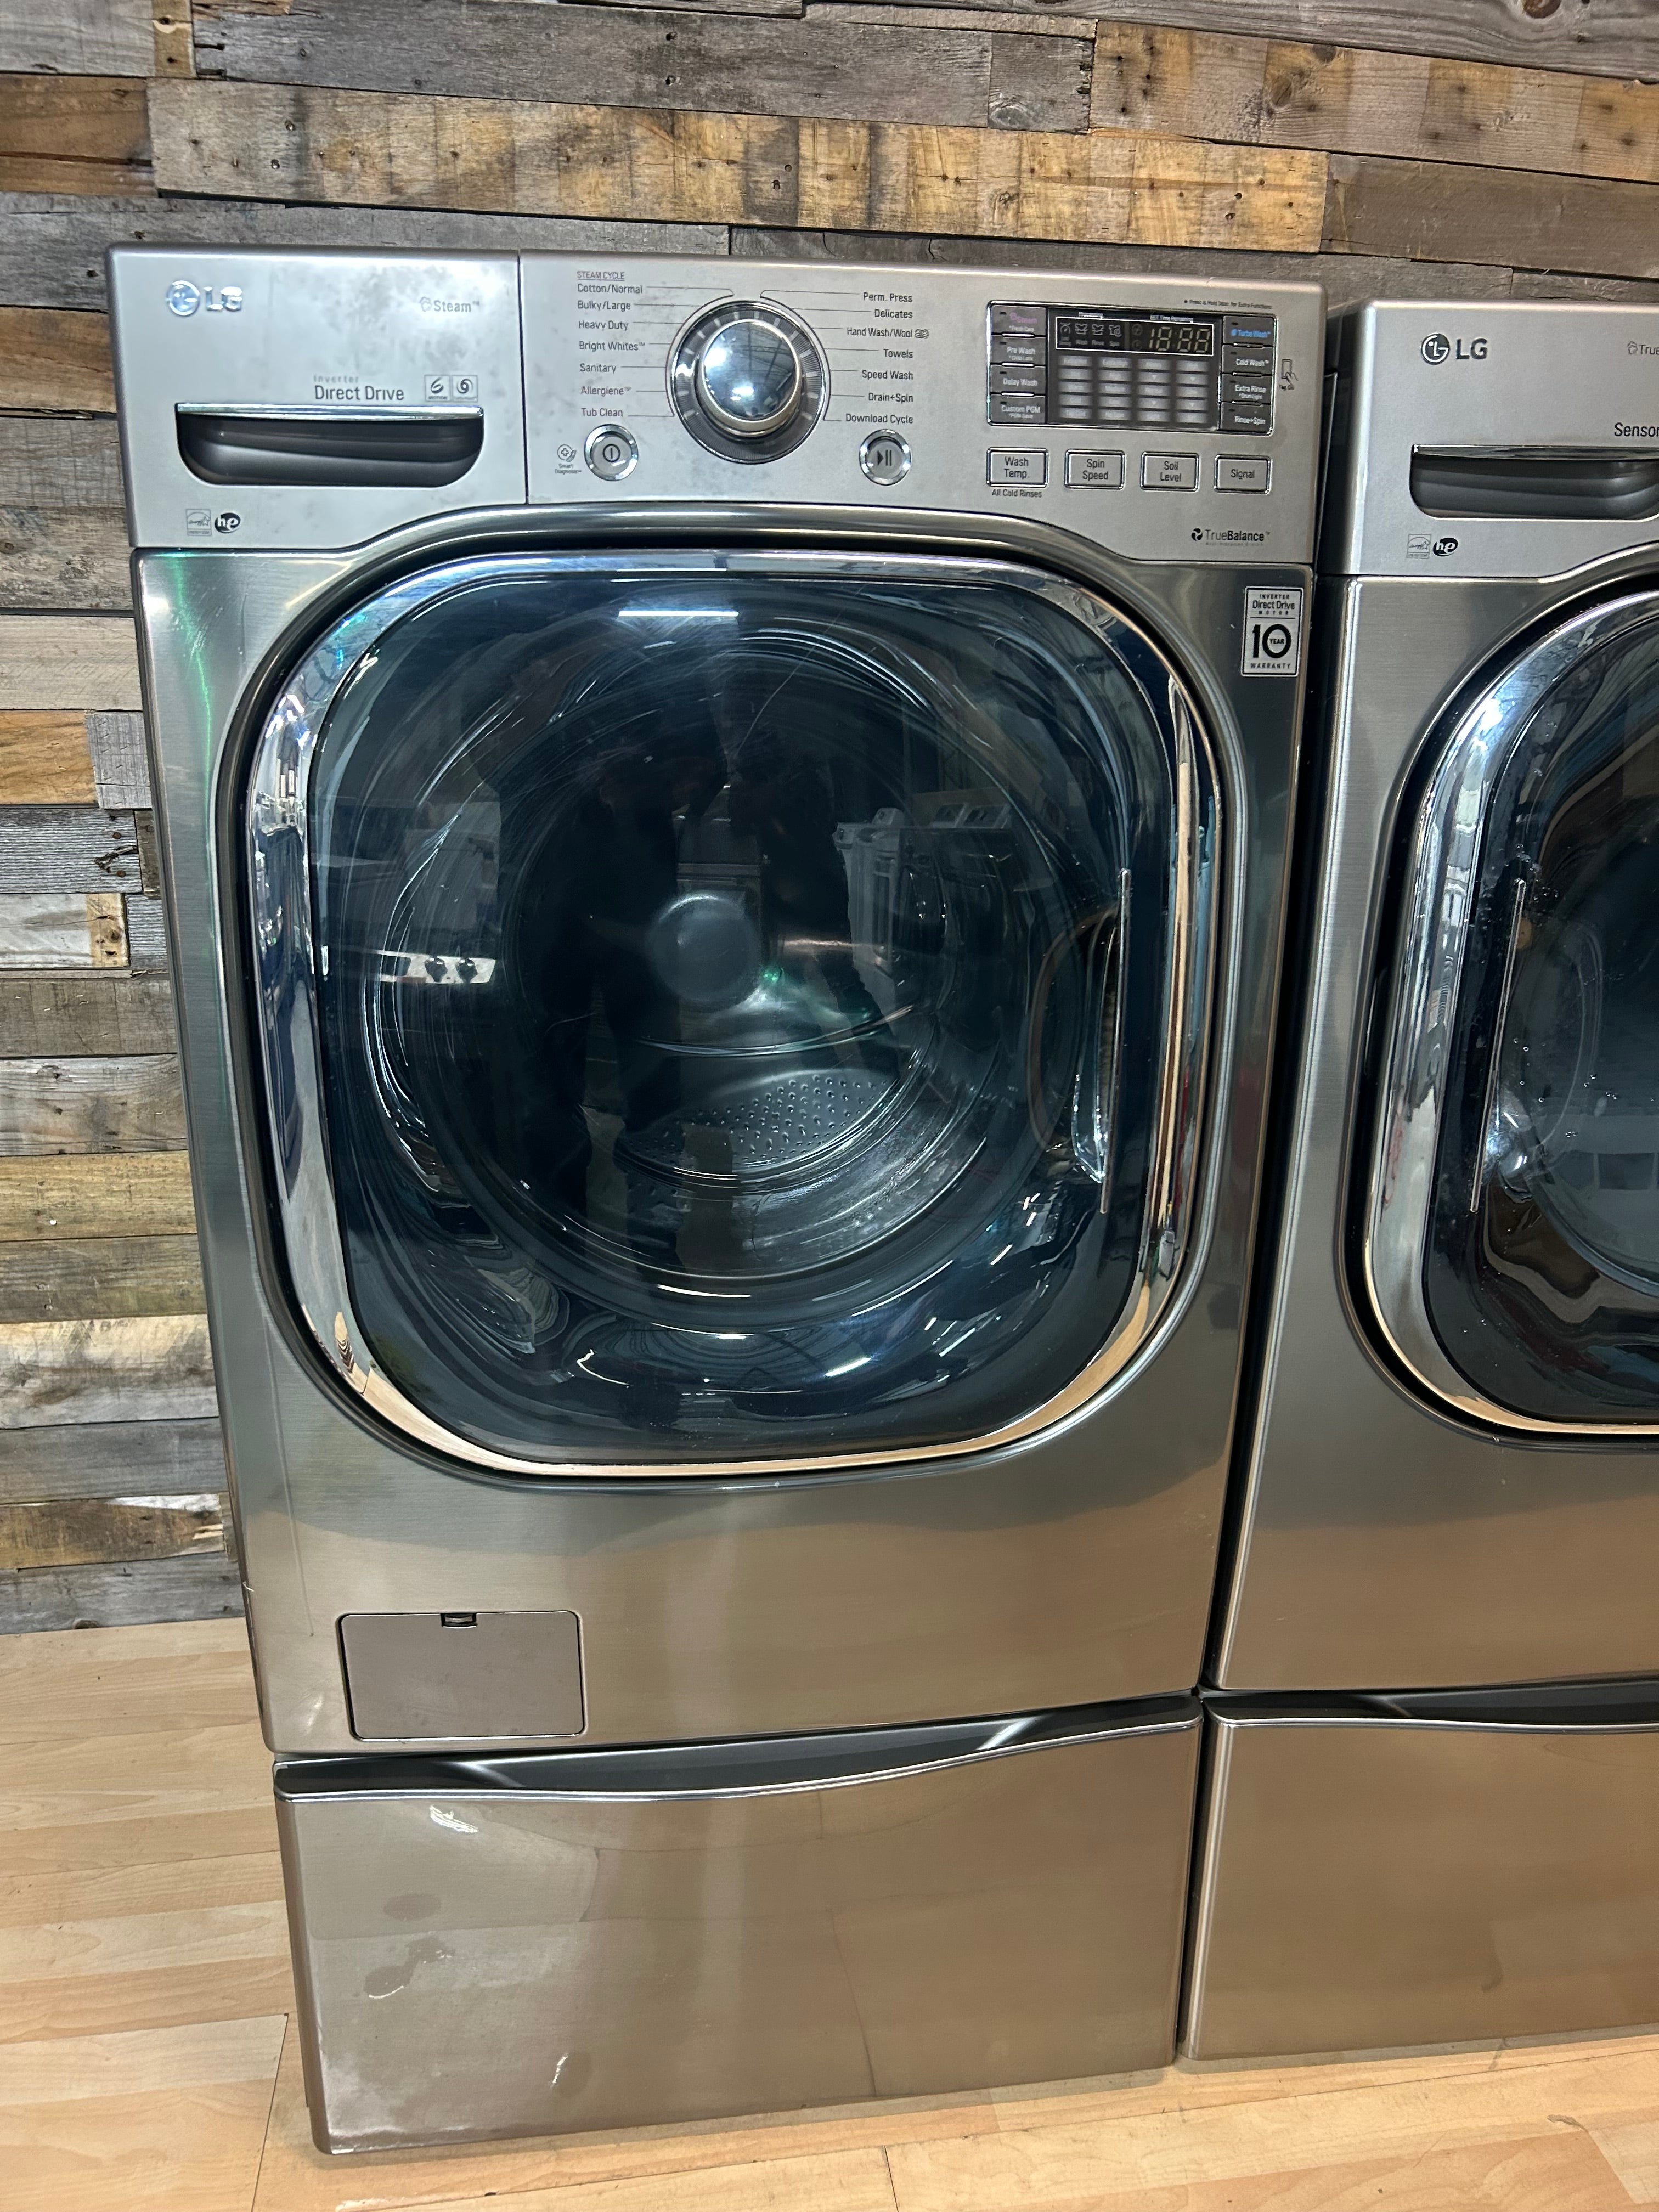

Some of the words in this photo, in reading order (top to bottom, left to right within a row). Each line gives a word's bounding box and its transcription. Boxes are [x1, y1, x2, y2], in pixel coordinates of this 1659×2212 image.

[577, 283, 642, 294] Cotton/Normal
[204, 286, 242, 311] LG
[864, 292, 888, 301] Perm.
[889, 293, 913, 302] Press
[578, 300, 631, 312] Bulky/Large
[874, 308, 913, 318] Delicates
[578, 320, 606, 331] Heavy
[608, 320, 629, 331] Duty
[847, 327, 866, 336] Hand
[868, 328, 912, 338] Wash/Wool
[579, 341, 606, 352] Bright
[1456, 338, 1487, 359] LG
[883, 349, 913, 358] Towels
[580, 363, 617, 374] Sanitary
[313, 374, 359, 383] Inverter
[862, 370, 888, 380] Speed
[890, 370, 913, 380] Wash
[1003, 378, 1020, 386] Delay
[315, 385, 360, 400] Direct
[365, 386, 404, 400] Drive
[868, 392, 913, 404] Drain+Spin
[582, 408, 597, 416] Tub
[599, 408, 623, 416] Clean
[845, 413, 888, 422] Download
[890, 415, 913, 425] Cycle
[1005, 456, 1029, 466] Wash
[1087, 459, 1105, 469] Spin
[1164, 461, 1178, 470] Soil
[1082, 471, 1109, 481] Speed
[1160, 472, 1181, 482] Level
[1231, 469, 1255, 480] Signal
[1252, 600, 1274, 609] Direct
[1276, 601, 1295, 610] Drive
[1252, 624, 1292, 658] 10
